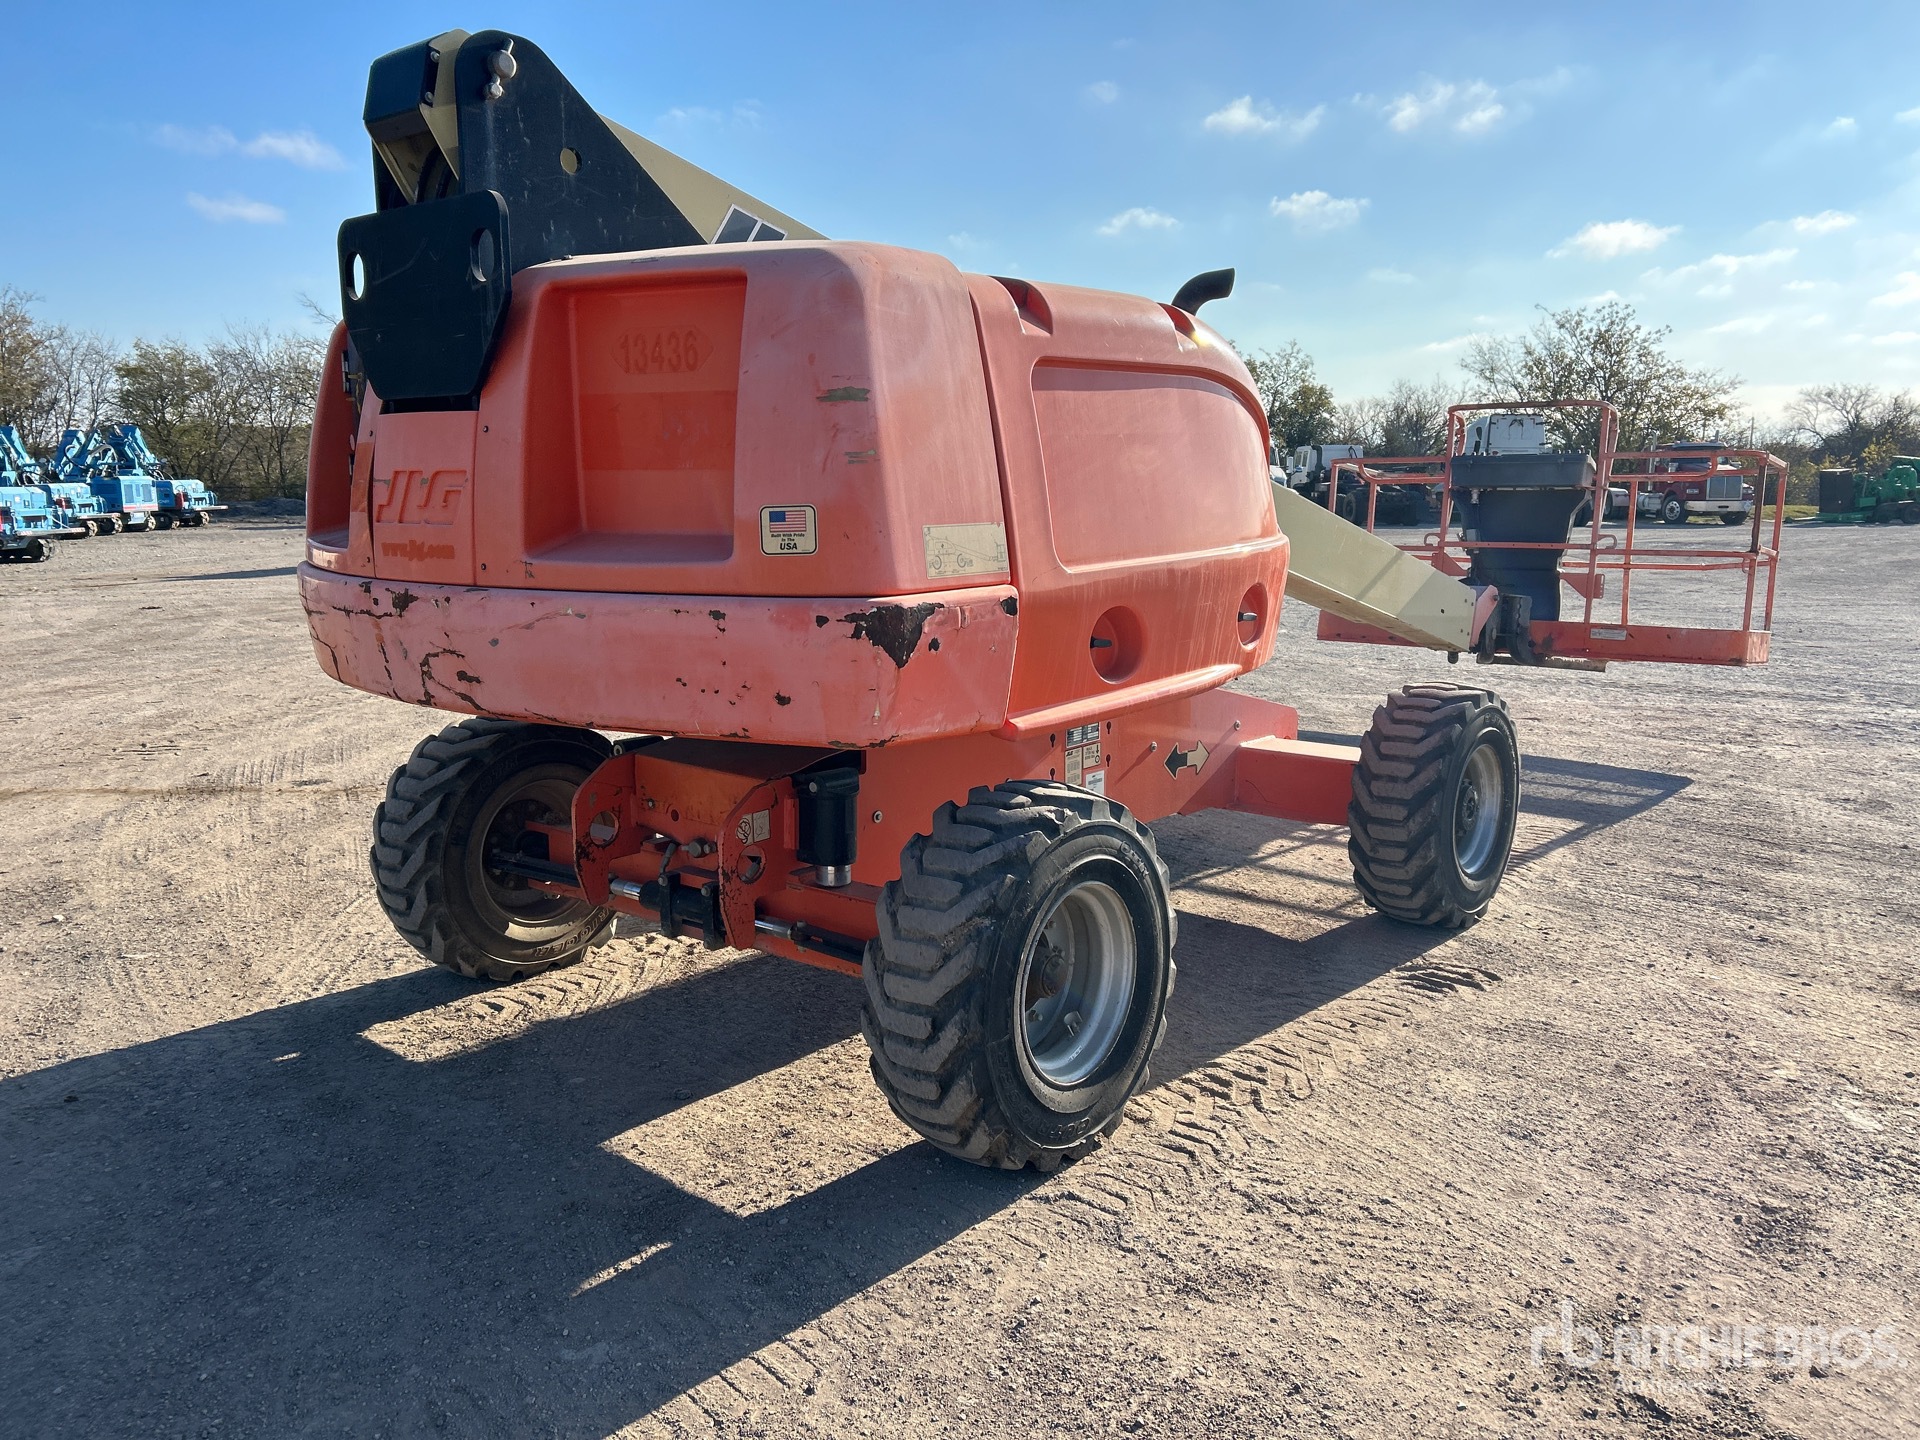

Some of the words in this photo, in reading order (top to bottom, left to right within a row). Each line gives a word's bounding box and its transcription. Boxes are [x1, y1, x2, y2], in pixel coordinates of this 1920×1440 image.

[619, 329, 699, 374] 13436
[376, 470, 467, 525] JLG
[780, 542, 798, 550] USA
